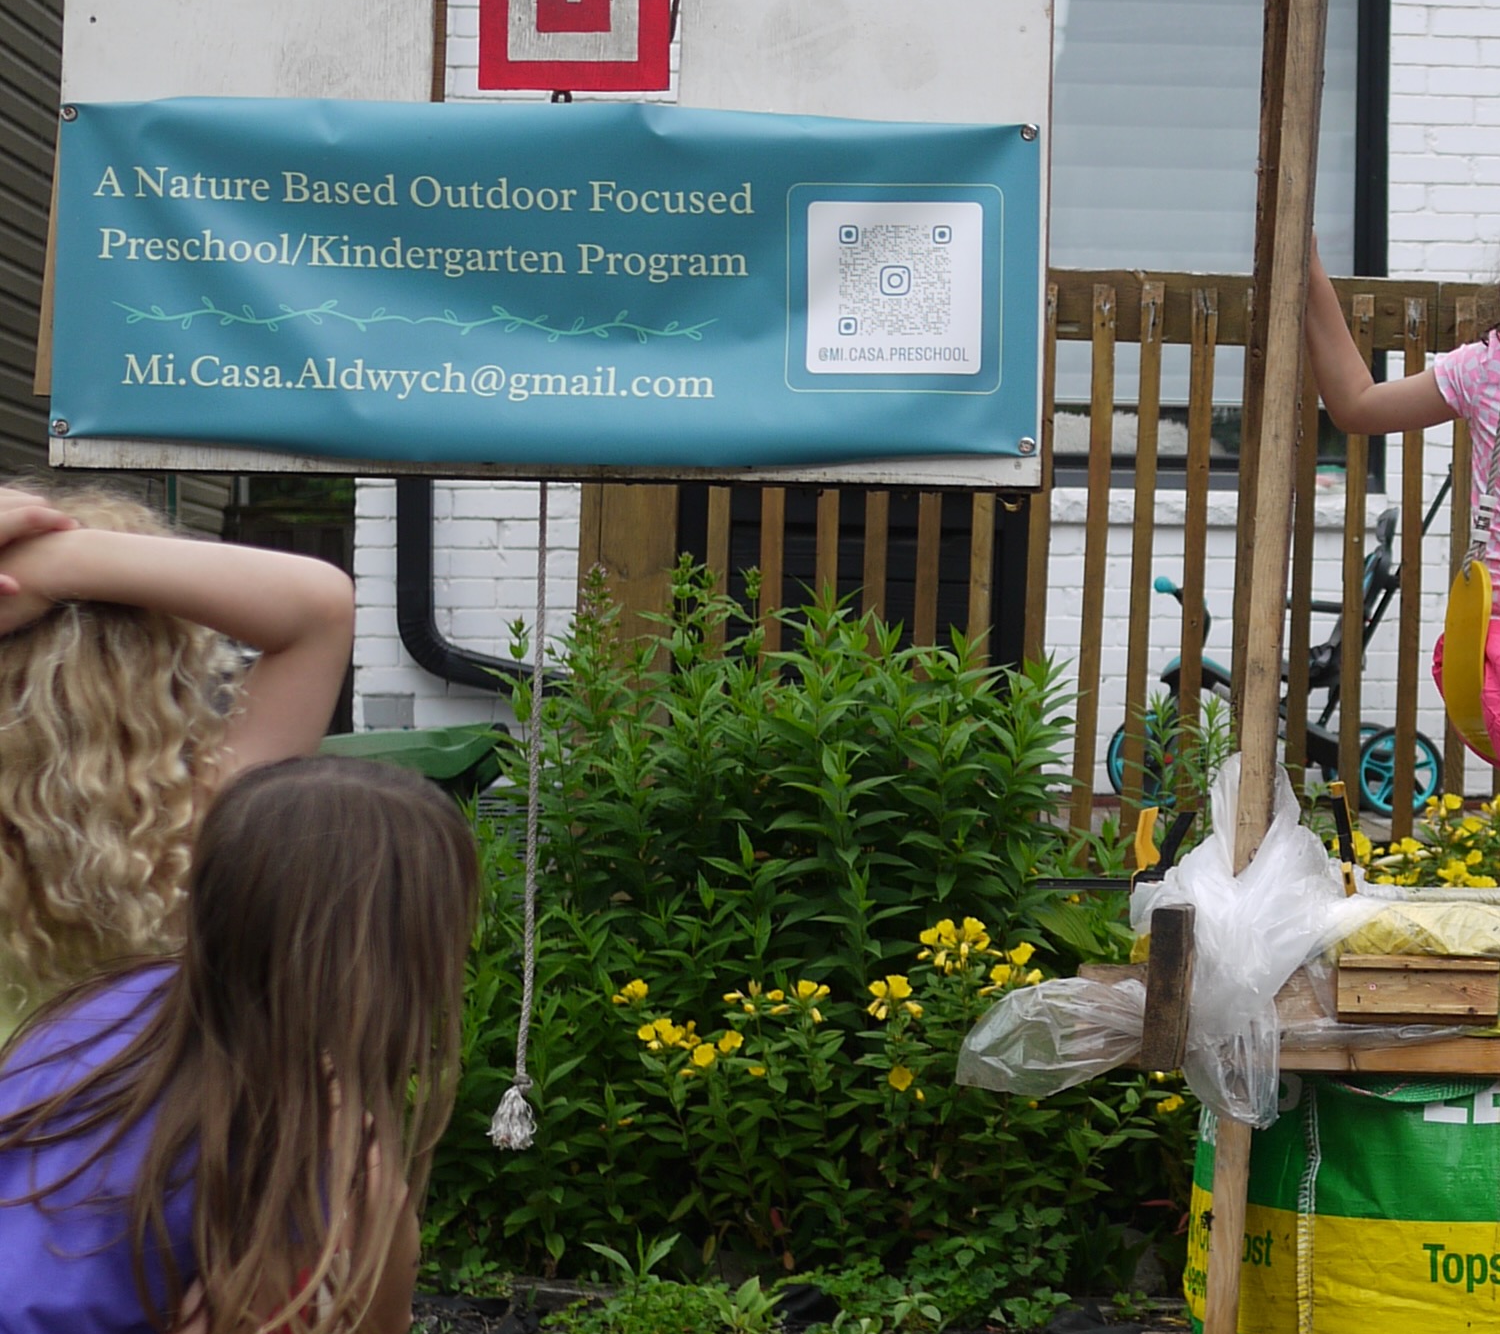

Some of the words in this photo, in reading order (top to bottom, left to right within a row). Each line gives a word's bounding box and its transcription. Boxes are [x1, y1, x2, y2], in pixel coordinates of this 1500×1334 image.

[92, 166, 125, 198] A
[132, 166, 271, 202] Nature
[281, 171, 398, 206] Based
[410, 175, 578, 211] Outdoor
[588, 180, 754, 215] Focused
[98, 227, 567, 278] Preschool/Kindergarten
[577, 243, 750, 283] Program
[122, 353, 716, 402] Mi.Casa.Aldwych@gmail.com
[818, 346, 970, 363] @MI.CASA.PRESCHOOL
